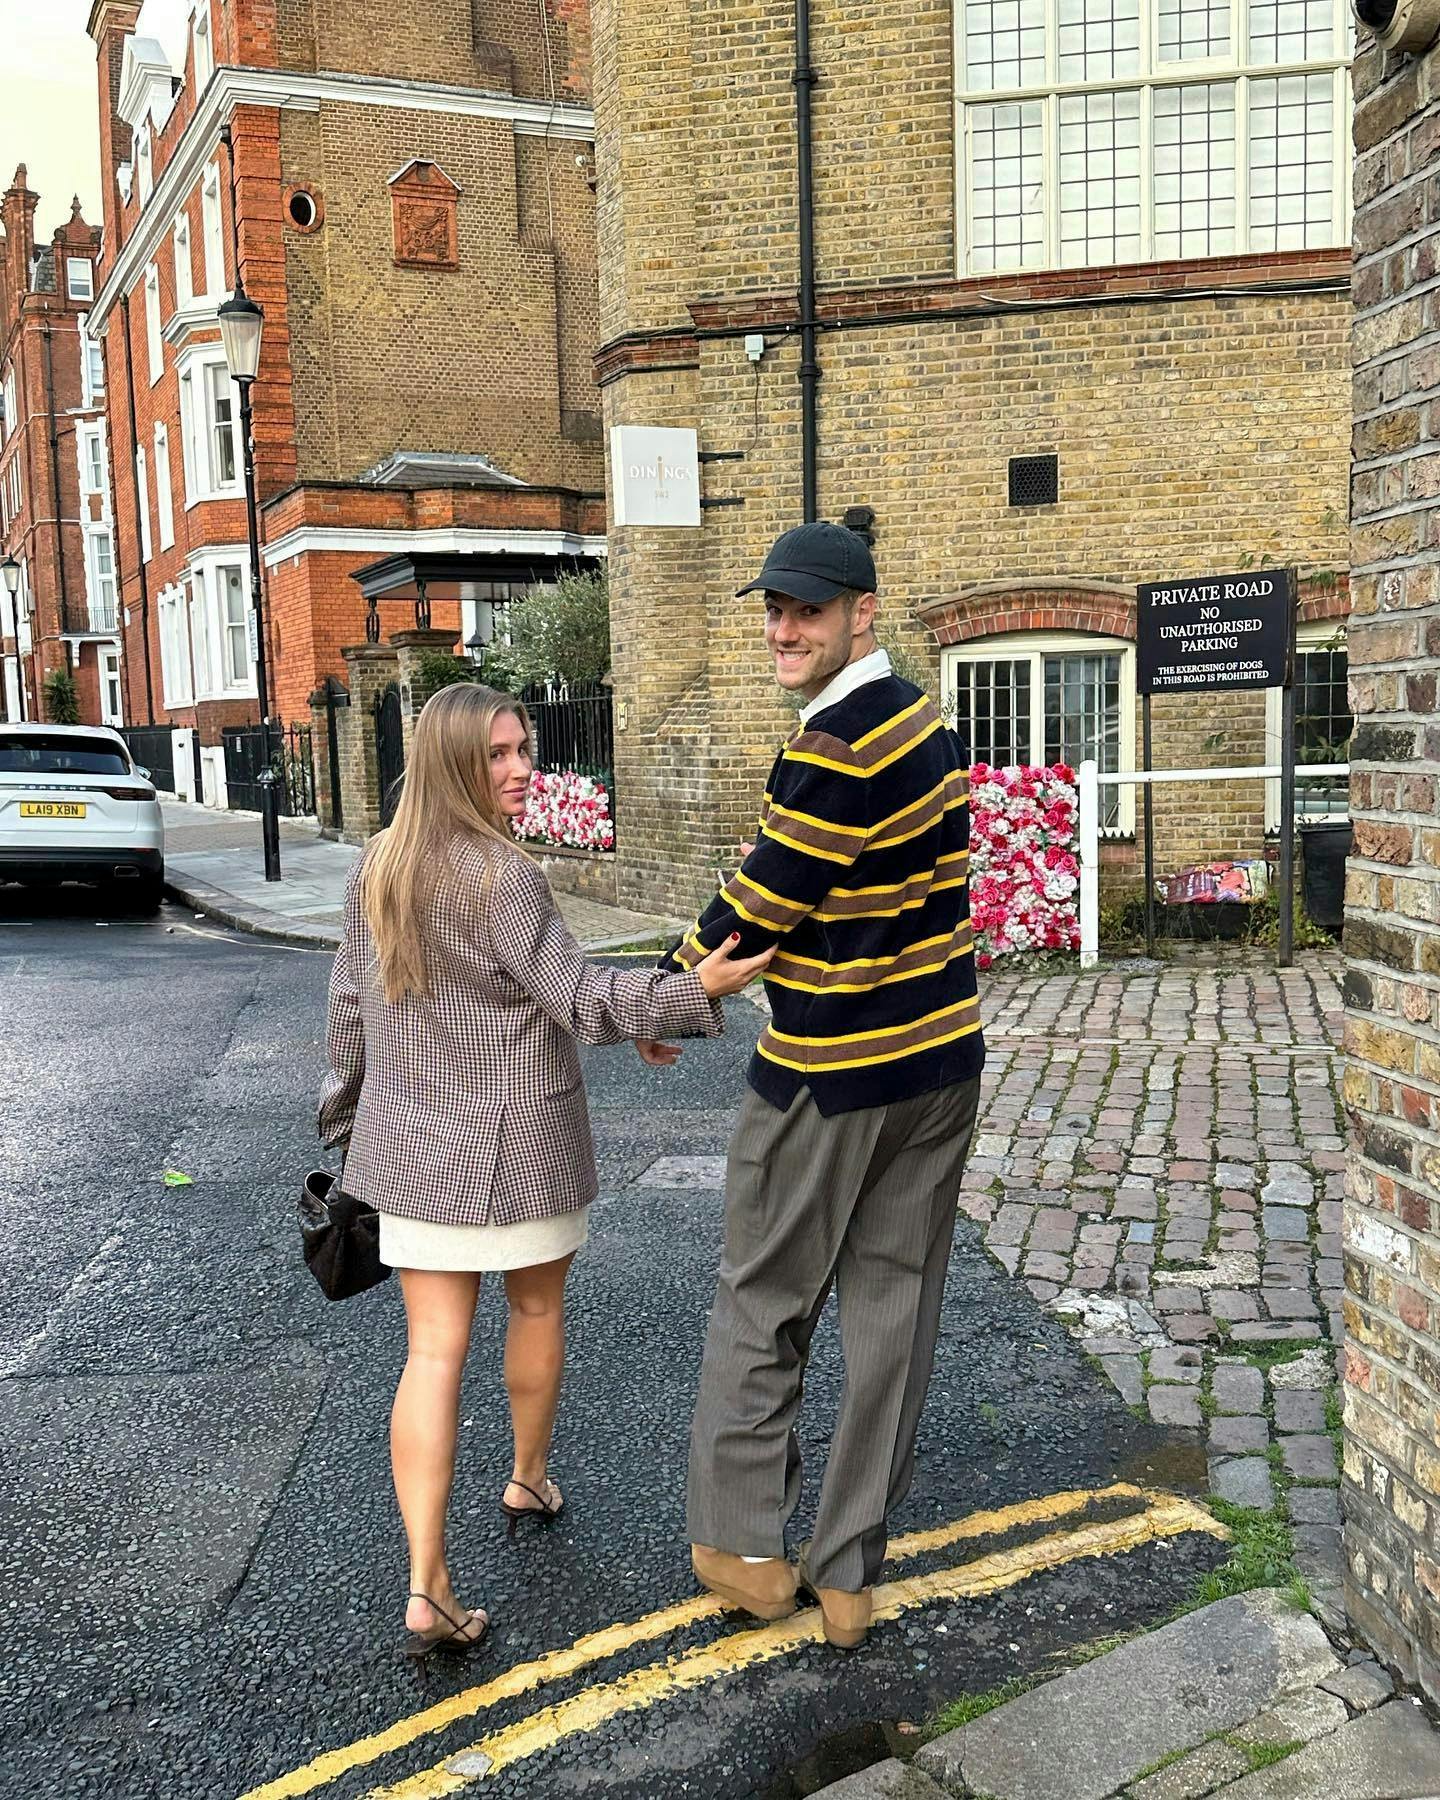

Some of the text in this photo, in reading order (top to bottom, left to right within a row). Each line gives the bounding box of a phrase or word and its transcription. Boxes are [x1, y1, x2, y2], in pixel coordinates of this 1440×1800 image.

[1151, 580, 1273, 606] PRIVATE ROAD
[1200, 606, 1220, 620] NO
[1160, 619, 1263, 639] UNAUTHORISED
[1181, 636, 1239, 652] PARKING
[1158, 660, 1263, 676] THE EXERCISING OF DOGS
[1152, 670, 1269, 685] IN THIS ROAD IS PROHIBITED
[27, 804, 79, 816] LA19 XBN
